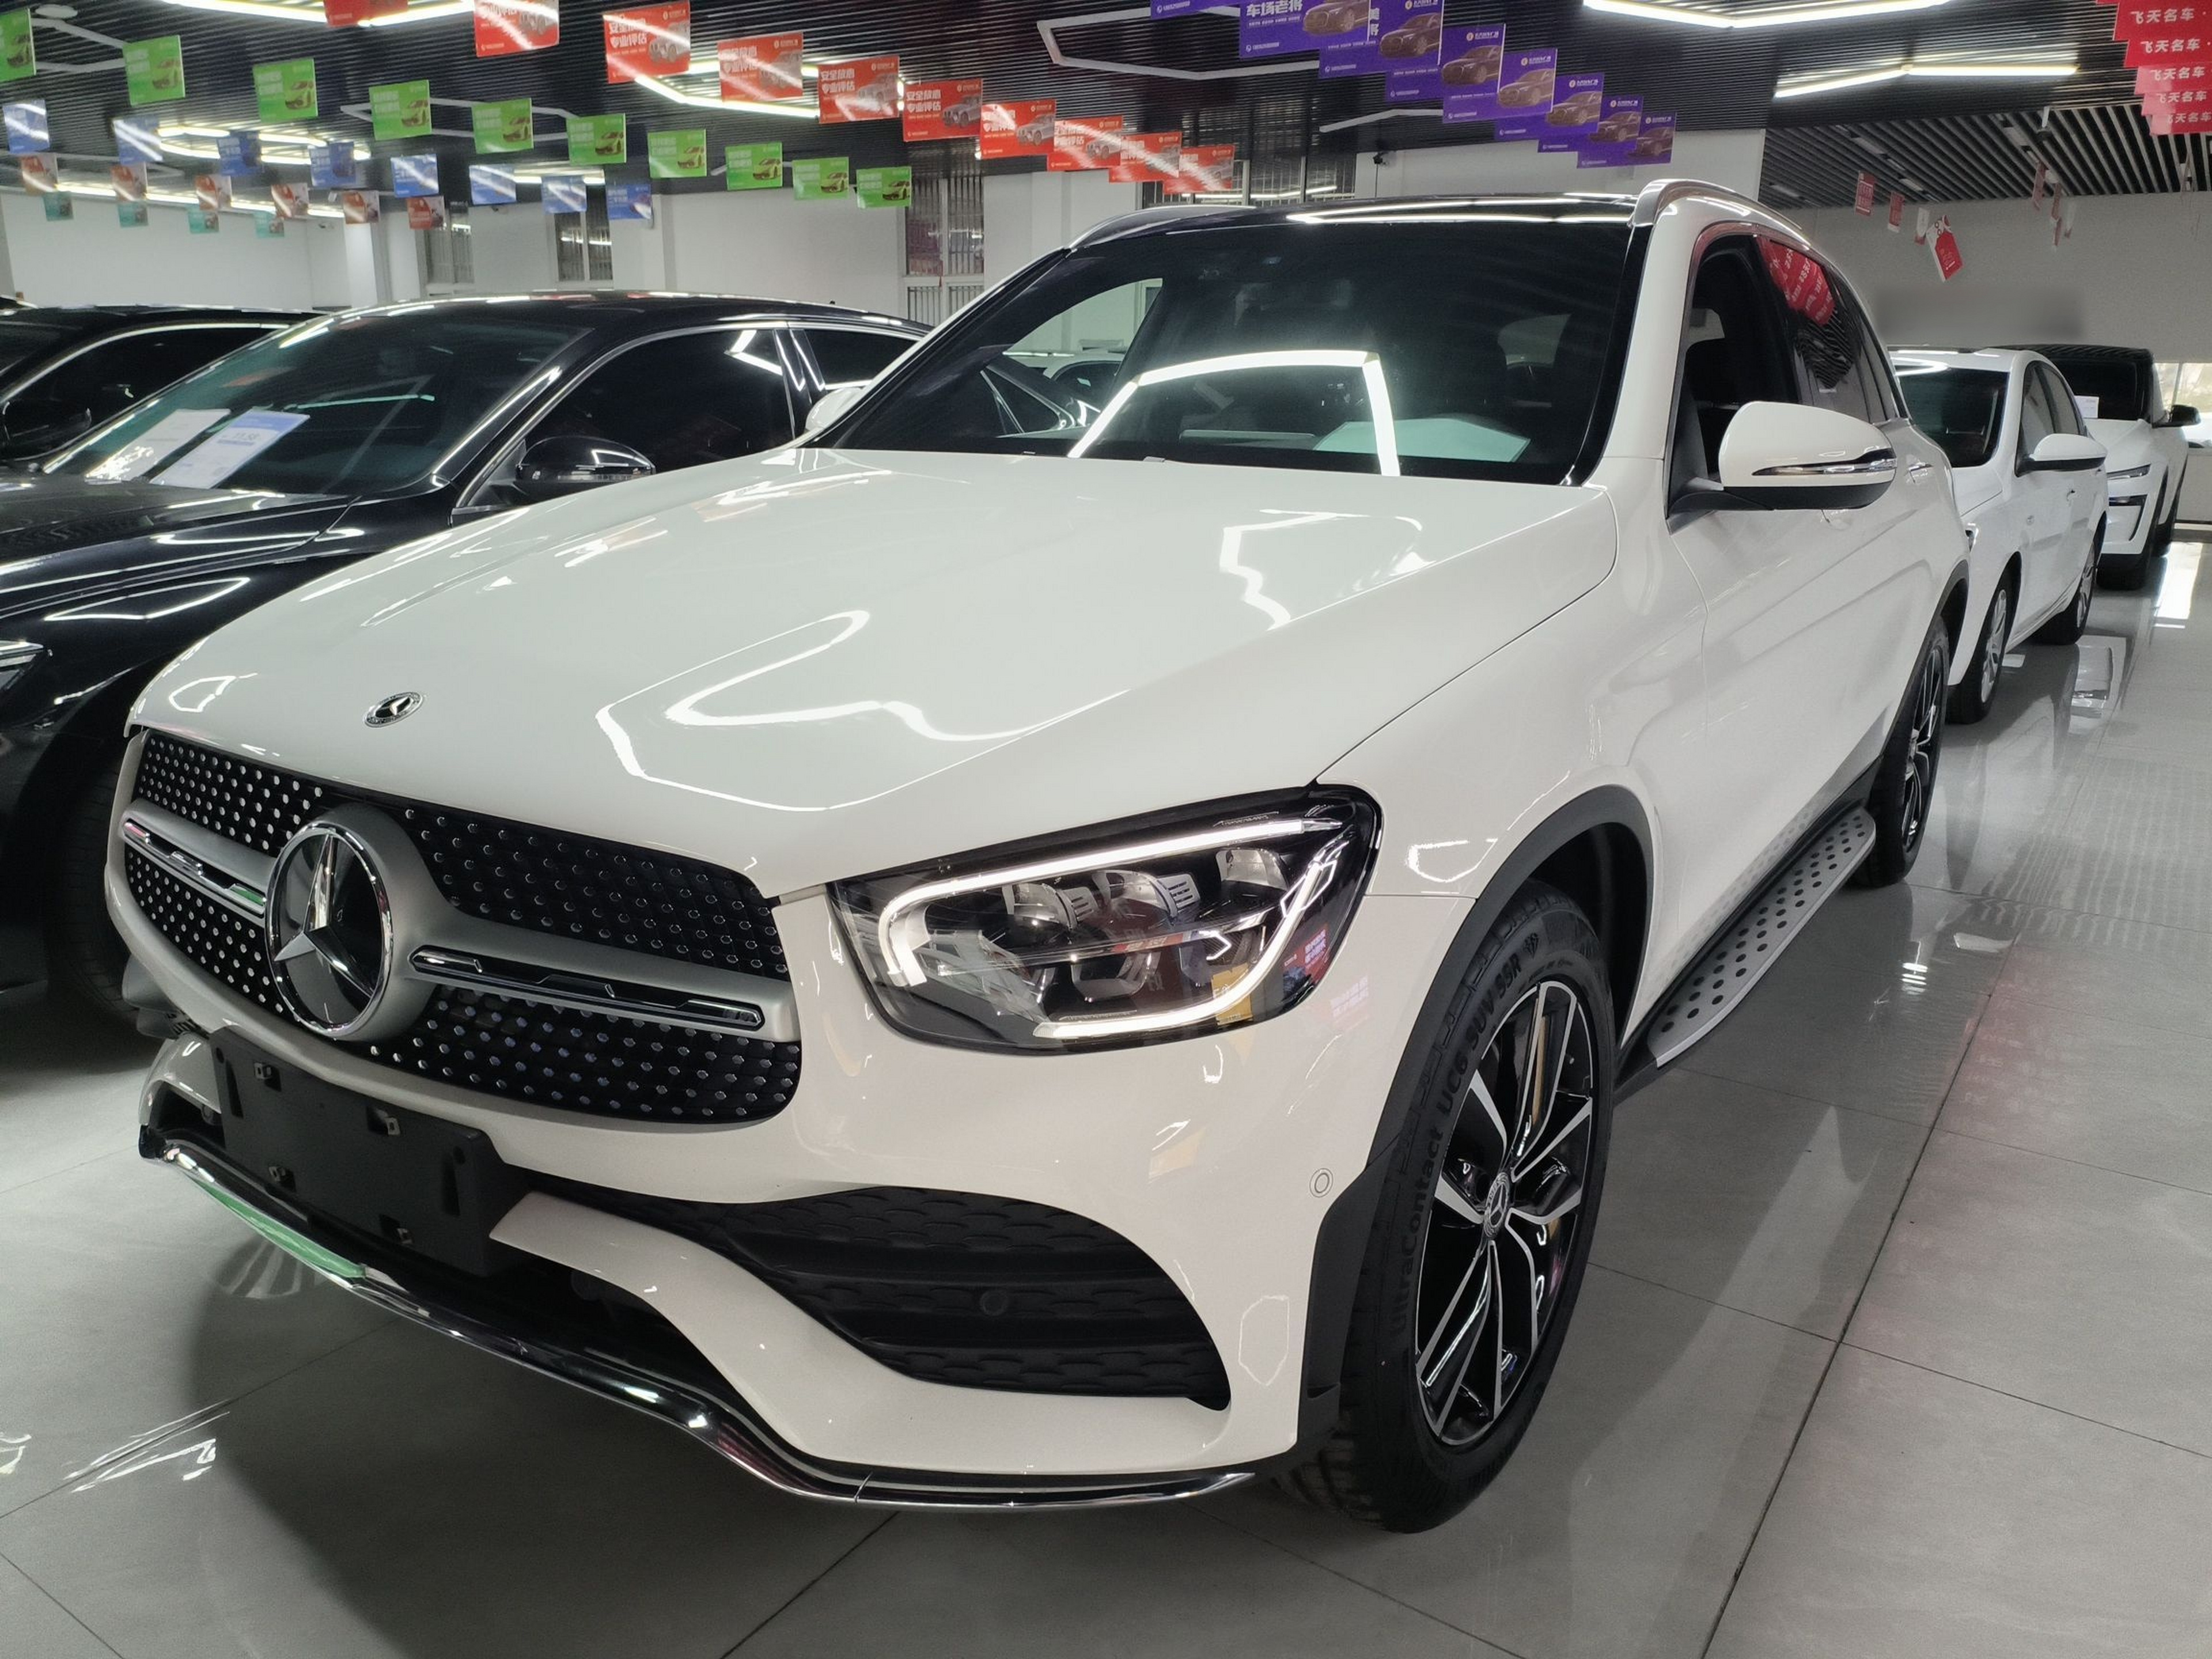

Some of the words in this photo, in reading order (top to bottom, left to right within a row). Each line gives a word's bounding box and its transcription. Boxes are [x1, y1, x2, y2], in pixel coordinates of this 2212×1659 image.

[2130, 7, 2195, 24] 飞天名车
[2140, 38, 2201, 54] 飞天名车
[2150, 66, 2206, 81] 飞天名车
[2156, 90, 2207, 104] 飞天名车
[1437, 1049, 1468, 1116] UC6
[1467, 988, 1495, 1051] SUV
[1495, 953, 1522, 999] SSR
